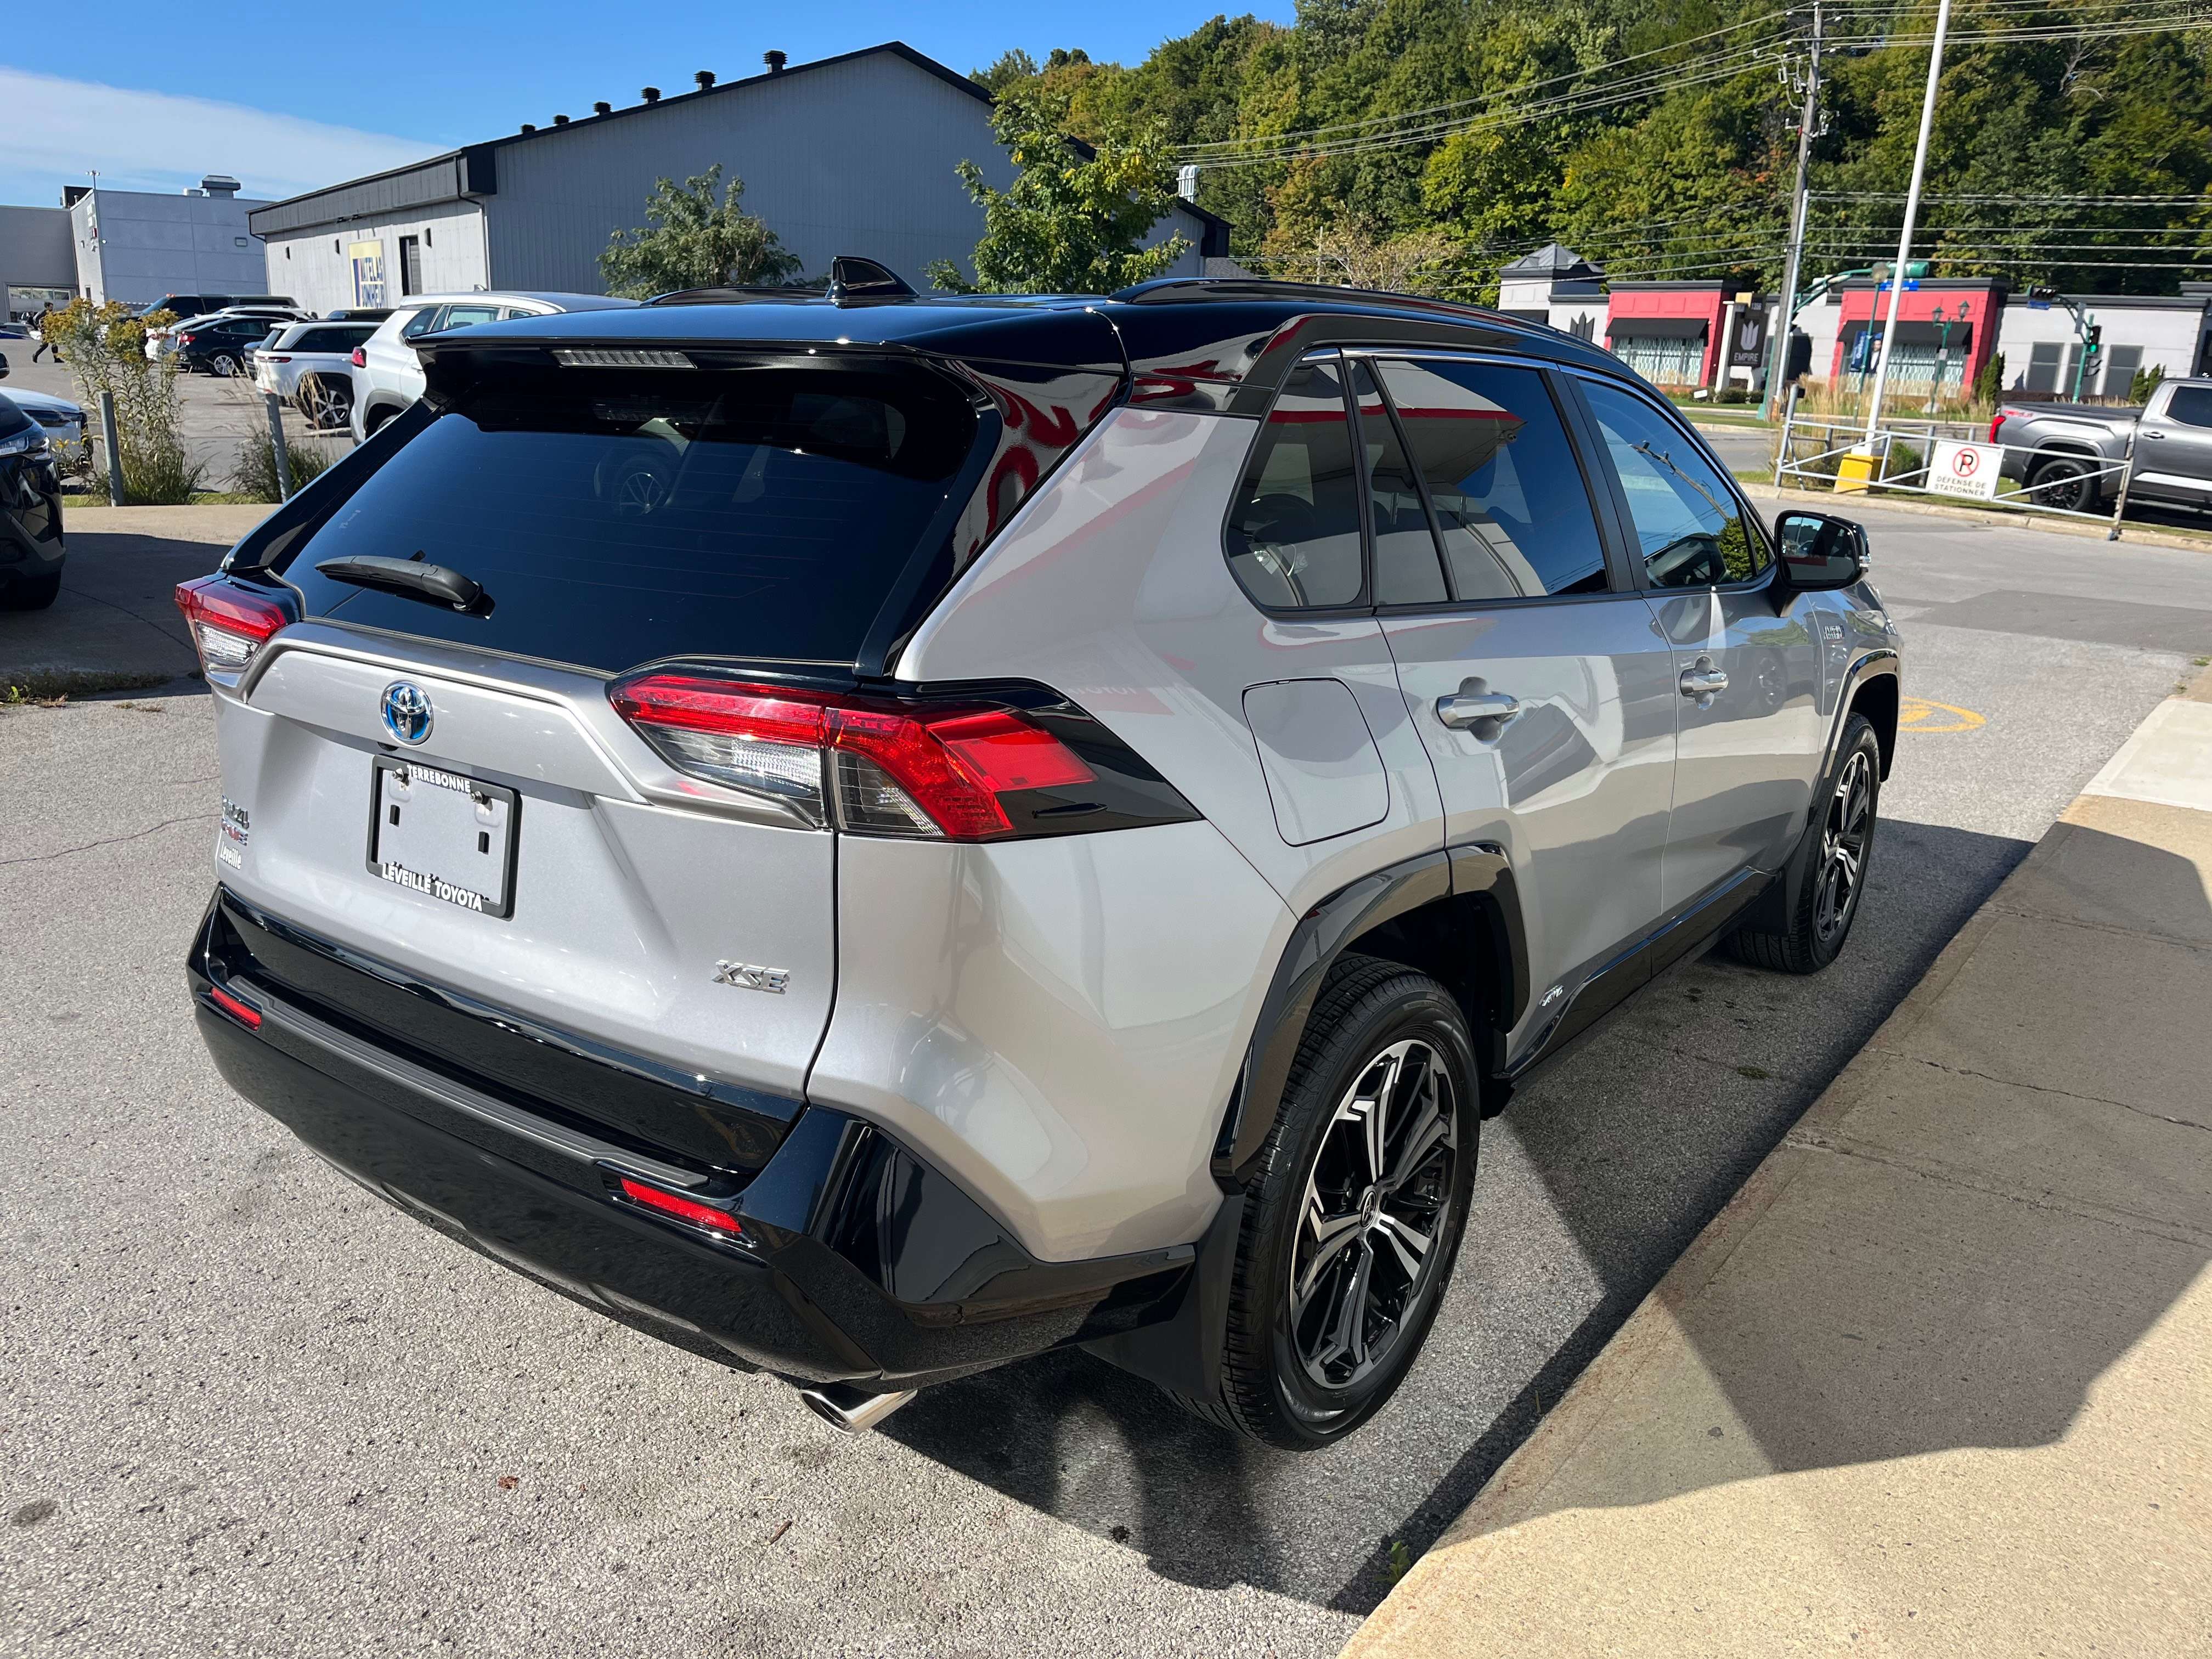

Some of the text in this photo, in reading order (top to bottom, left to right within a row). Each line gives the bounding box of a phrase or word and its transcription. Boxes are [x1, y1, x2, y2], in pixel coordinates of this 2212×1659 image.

[1734, 352, 1759, 362] EMPIRE
[1959, 454, 1973, 472] P
[1934, 483, 1985, 496] STATIONNER
[407, 764, 471, 793] TERREBONNE
[382, 861, 483, 912] LÉVEILLÉ TOYOTA
[712, 960, 791, 995] XSE
